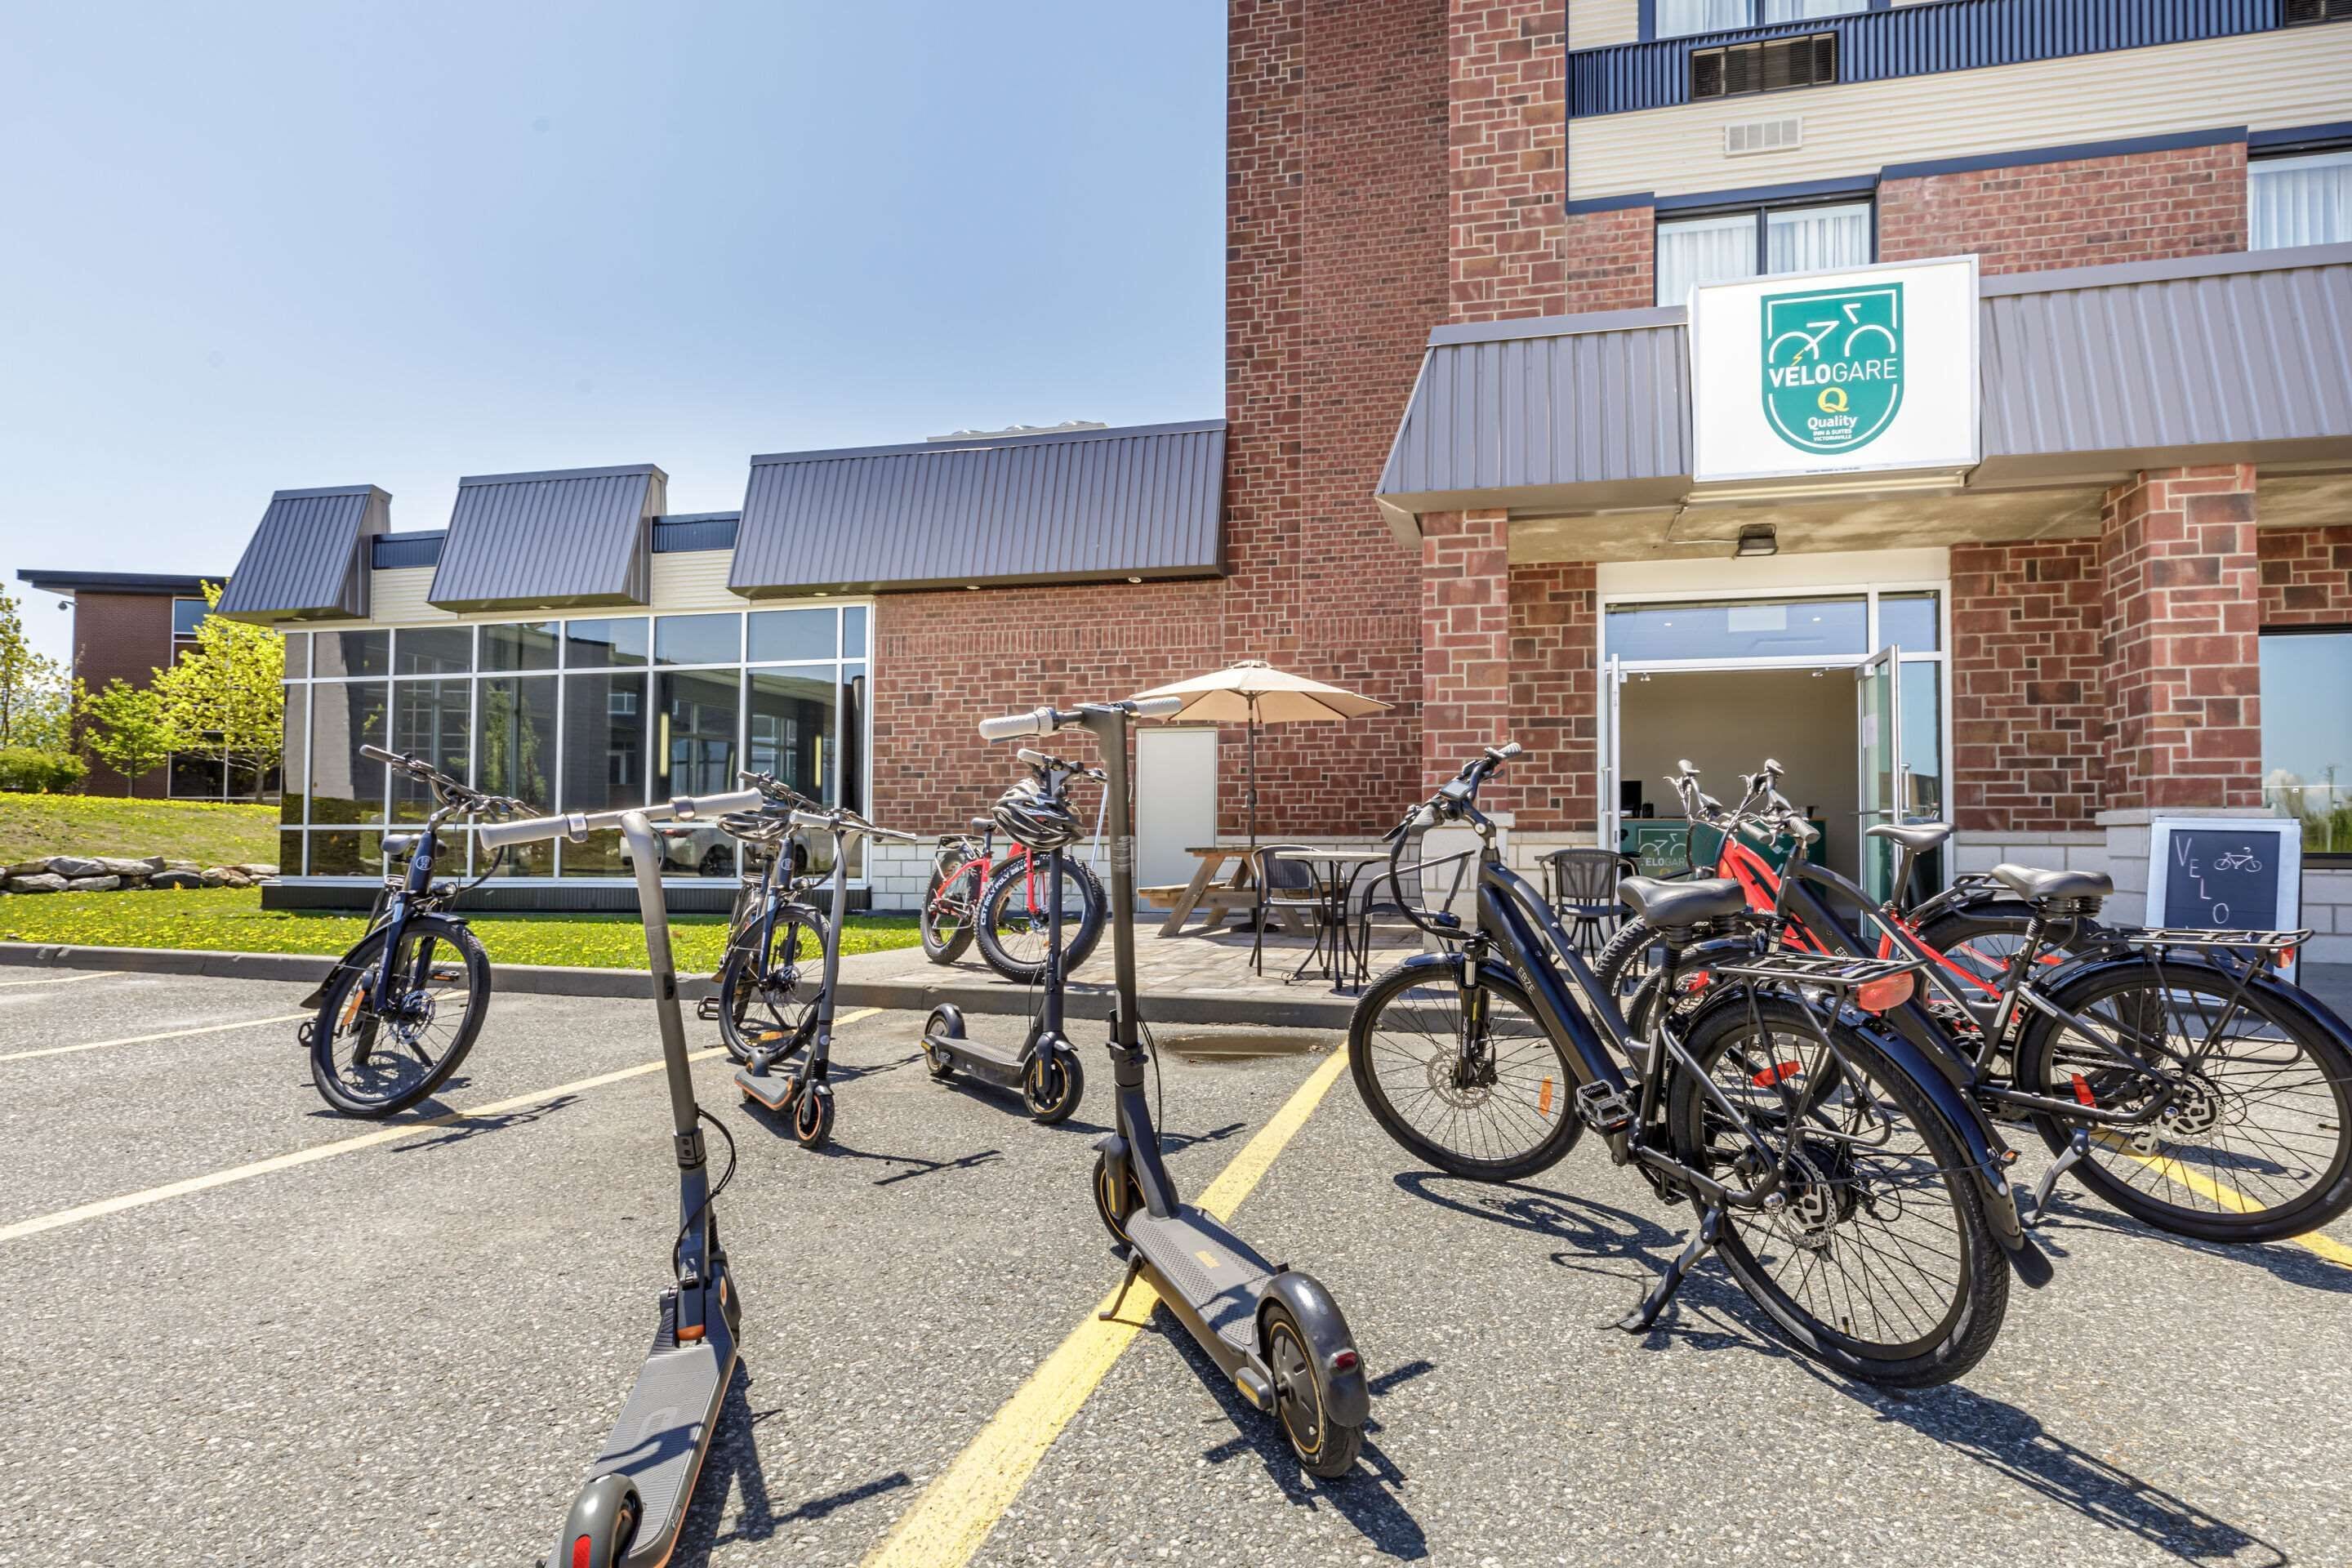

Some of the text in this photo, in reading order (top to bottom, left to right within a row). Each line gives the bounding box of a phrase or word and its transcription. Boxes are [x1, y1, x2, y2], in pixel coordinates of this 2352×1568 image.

[1818, 386, 1849, 412] Q
[1807, 415, 1859, 430] Quality
[984, 887, 996, 906] ROLY
[994, 872, 1010, 889] POLY
[1517, 966, 1535, 995] EBZE
[1611, 973, 1622, 996] CST
[1620, 949, 1637, 972] ROLY
